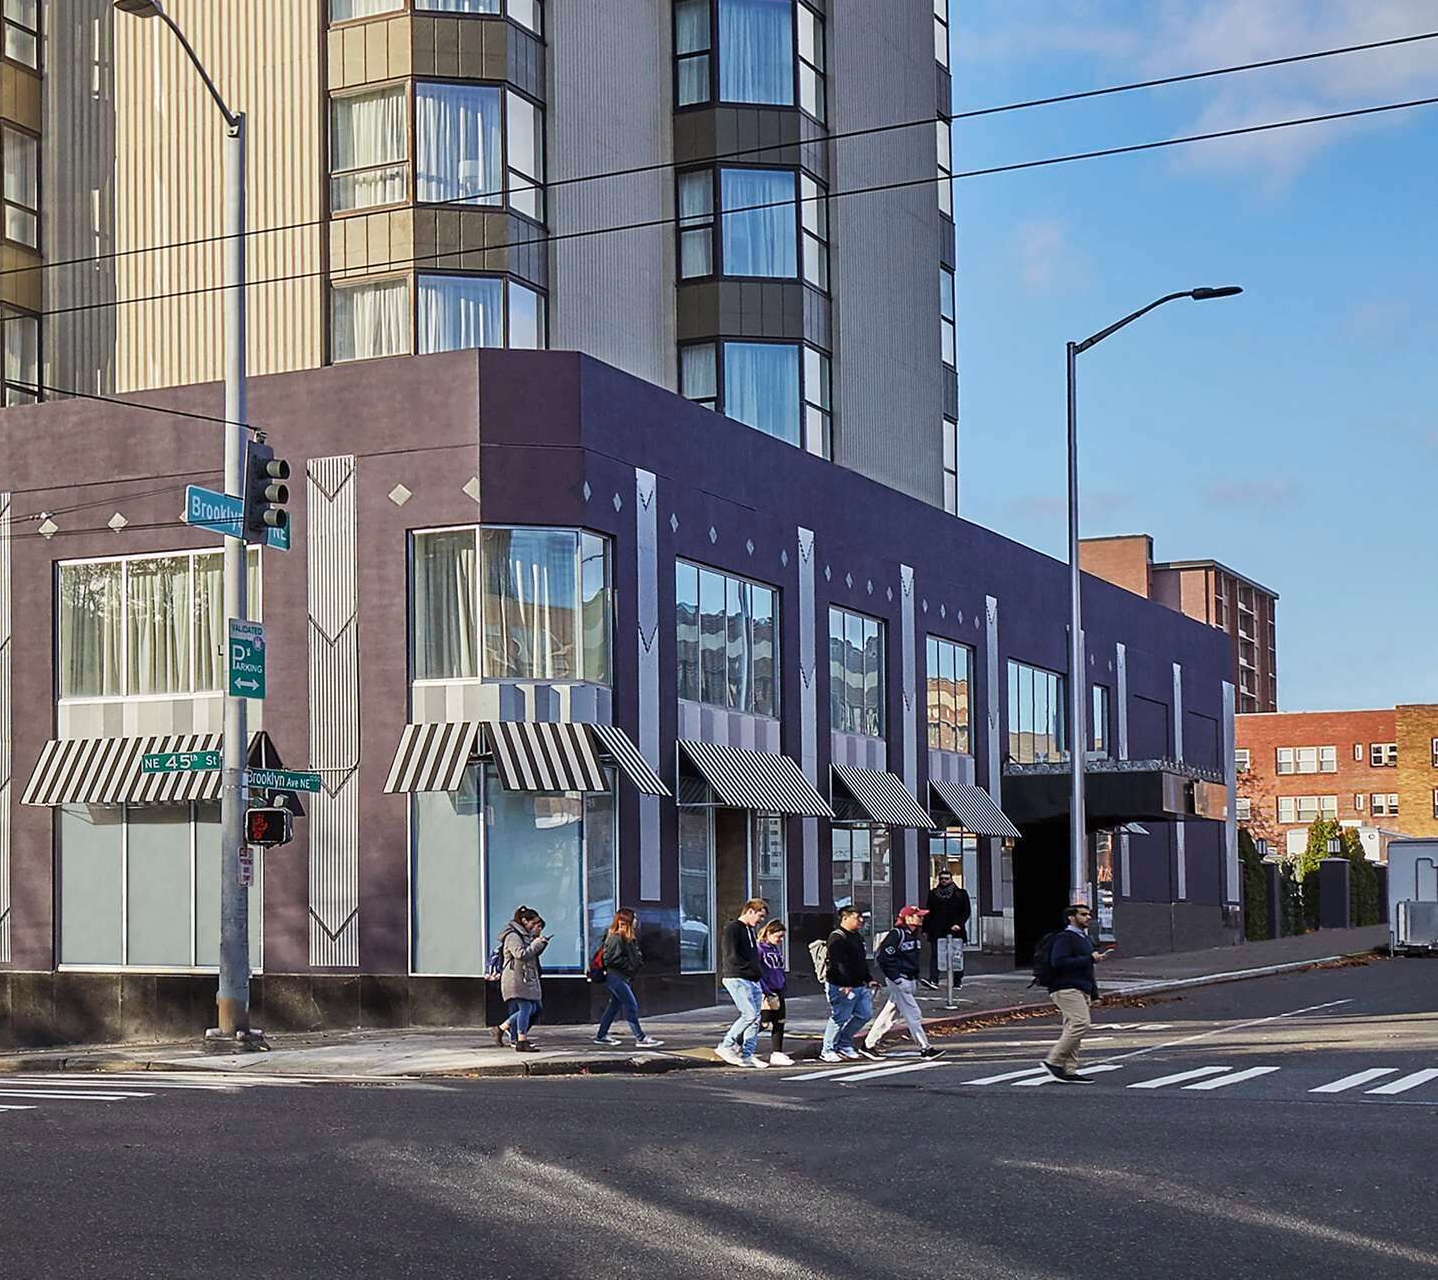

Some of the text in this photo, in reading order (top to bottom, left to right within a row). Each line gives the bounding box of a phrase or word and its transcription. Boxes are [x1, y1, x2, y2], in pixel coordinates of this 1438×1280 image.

[231, 623, 263, 636] VALIDATED
[144, 754, 218, 769] NE 45th St
[248, 770, 285, 788] Brooklyn
[286, 778, 299, 788] Ave
[300, 778, 310, 789] NE
